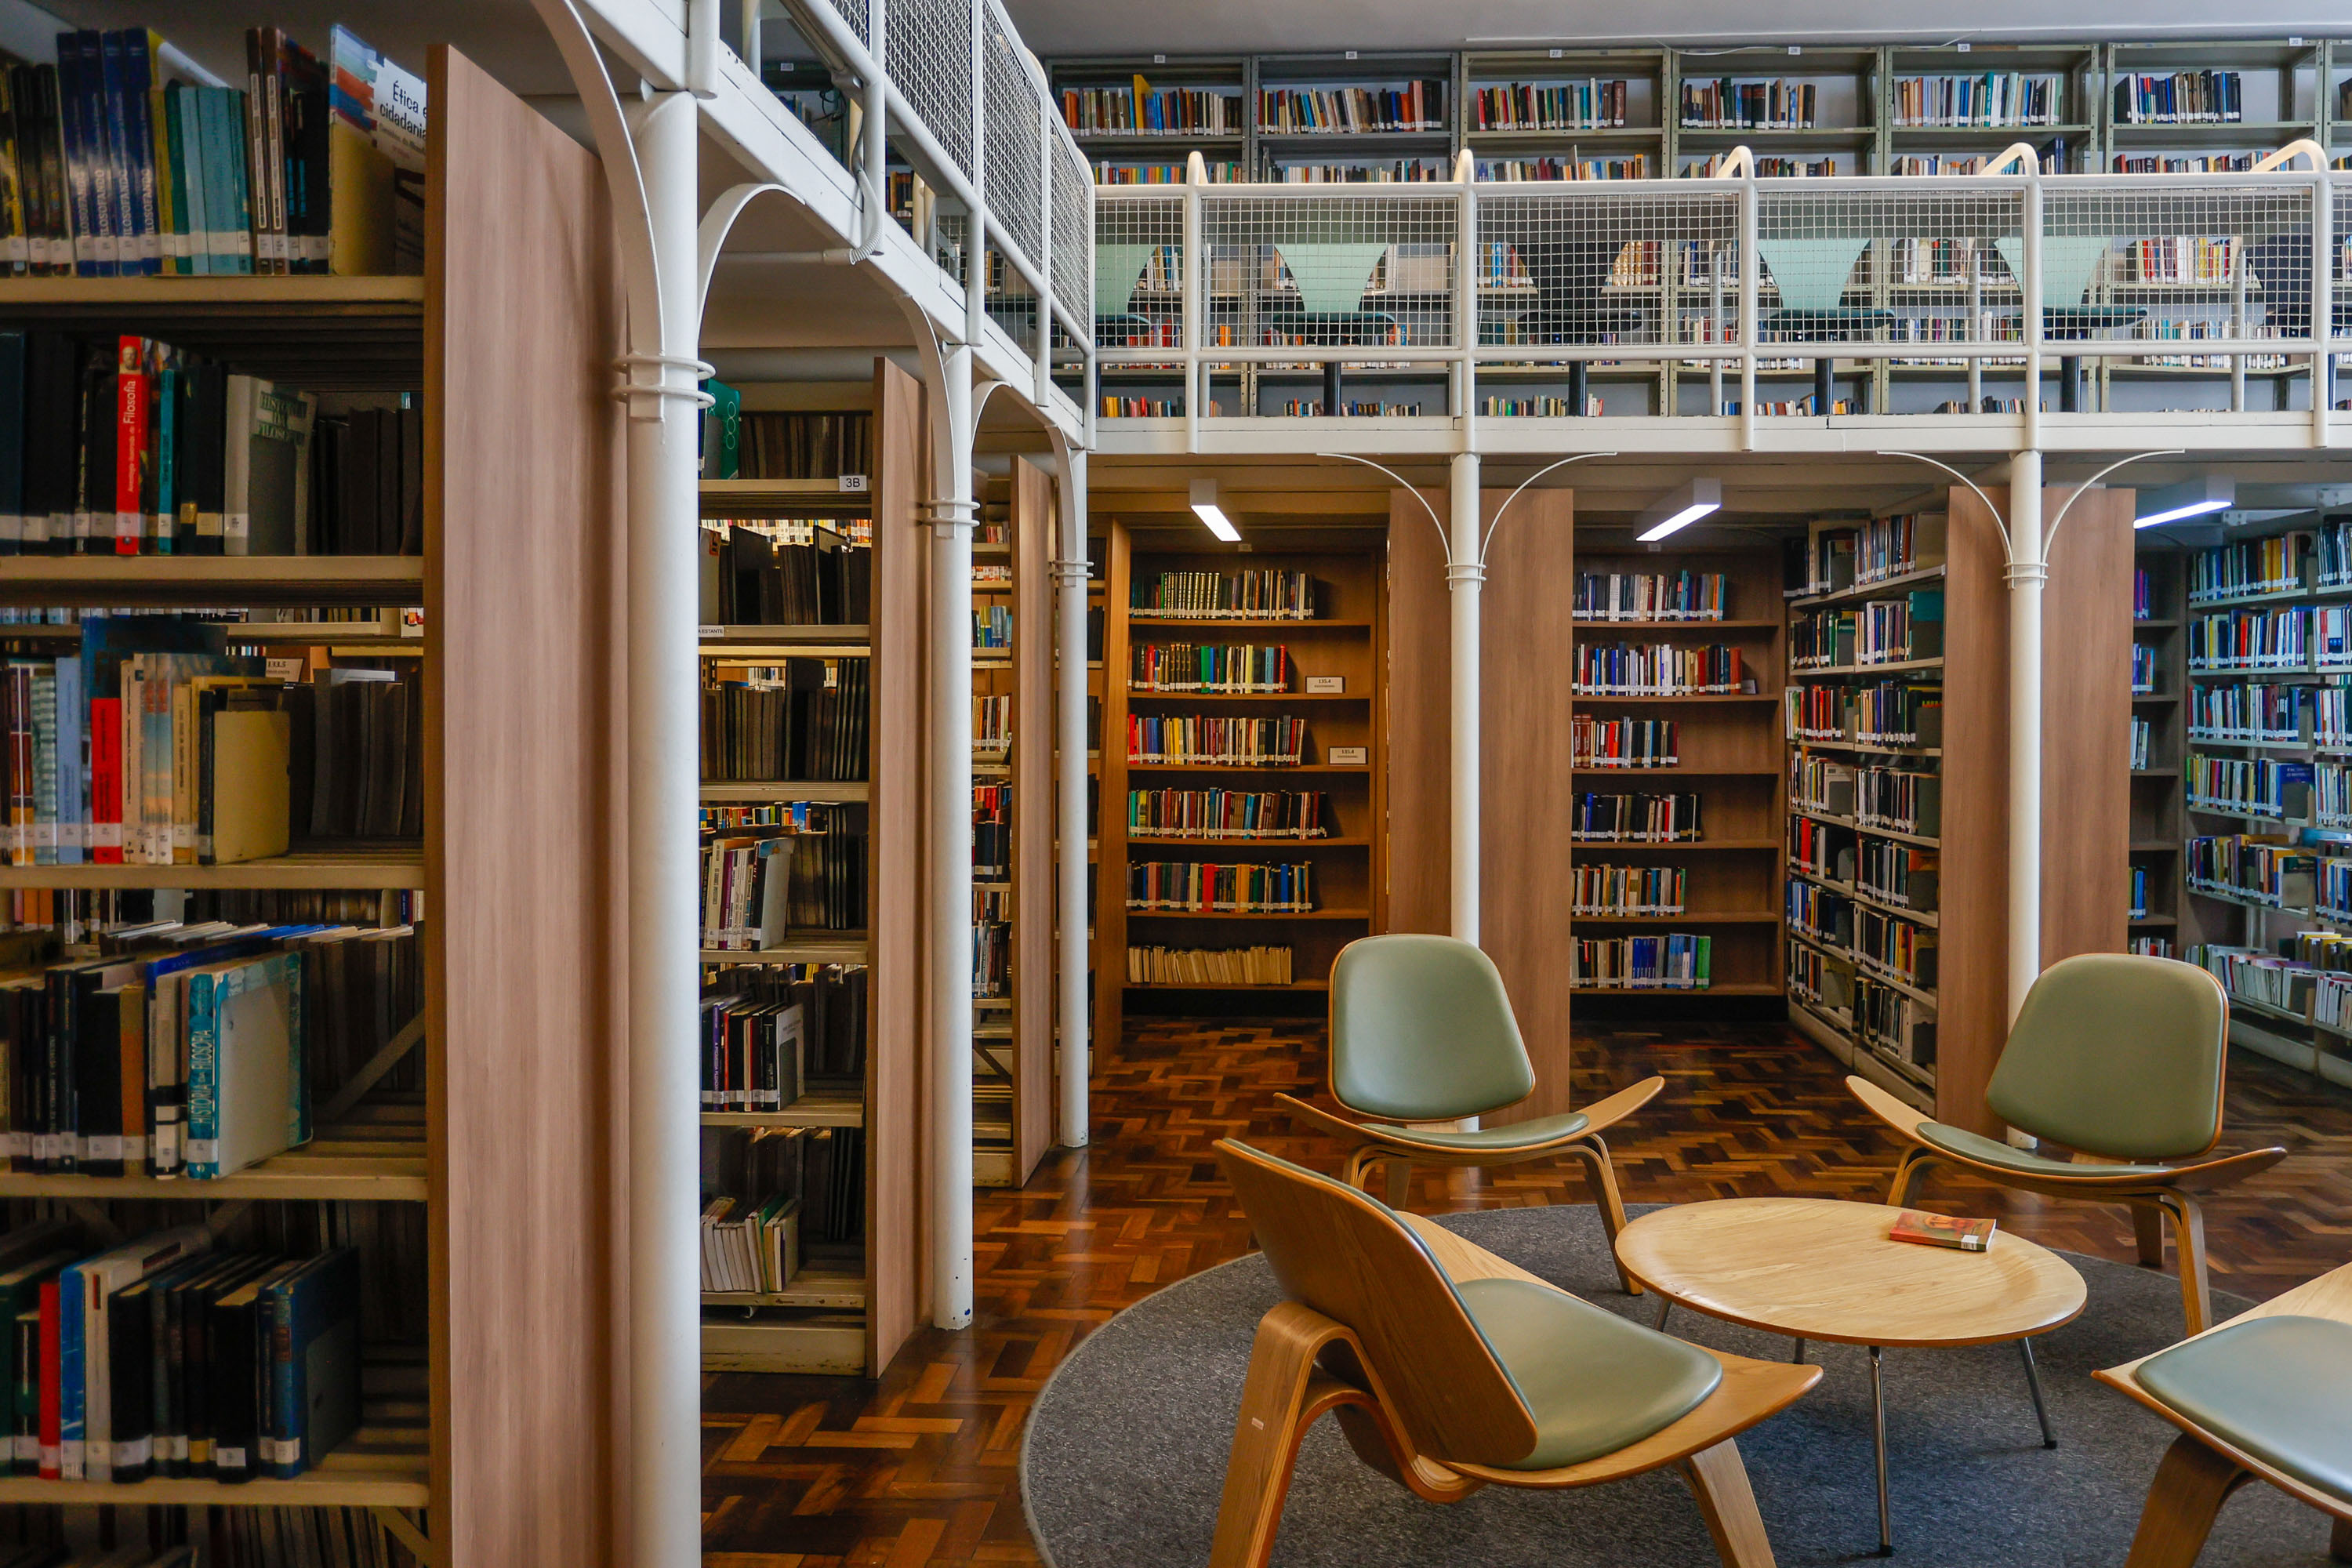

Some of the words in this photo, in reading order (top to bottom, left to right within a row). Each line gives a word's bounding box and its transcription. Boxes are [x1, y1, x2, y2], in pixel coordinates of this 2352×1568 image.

[393, 80, 419, 114] Ética
[379, 103, 427, 140] cidadania
[123, 380, 136, 424] Filosofia
[846, 477, 861, 488] 3B
[191, 1029, 213, 1070] FILOSOFIA
